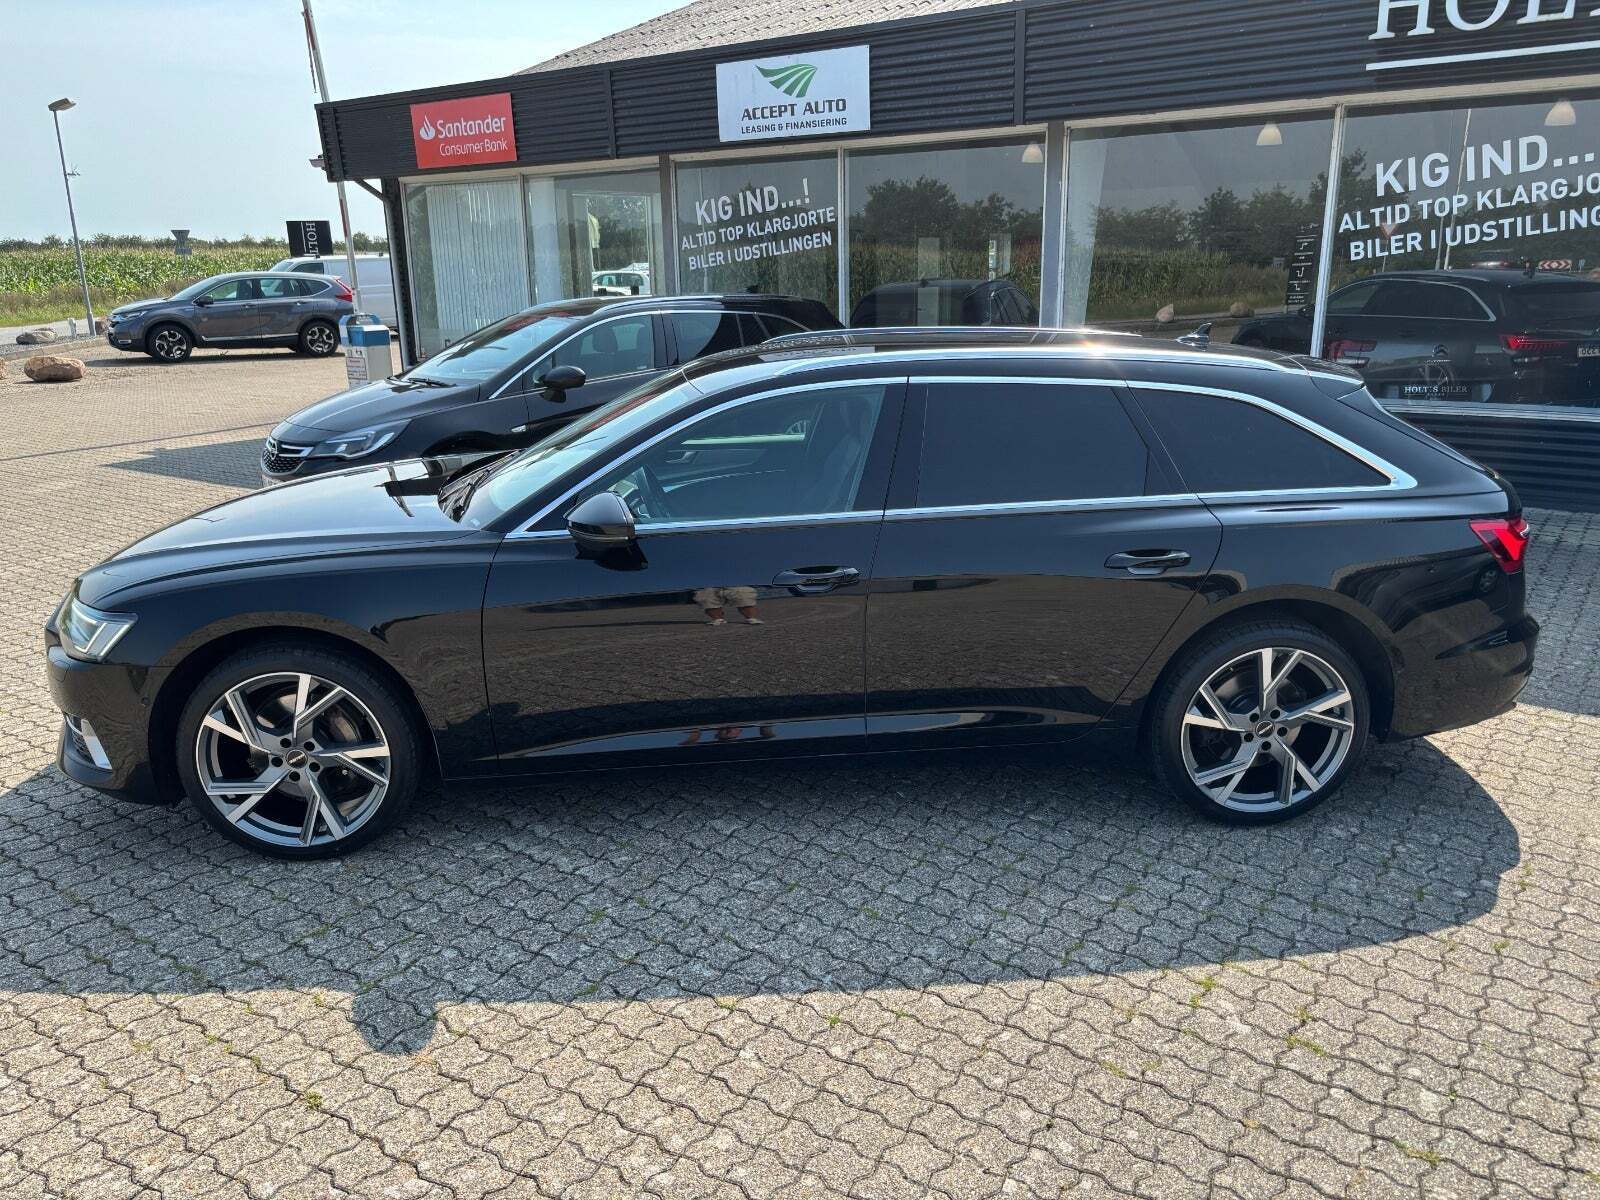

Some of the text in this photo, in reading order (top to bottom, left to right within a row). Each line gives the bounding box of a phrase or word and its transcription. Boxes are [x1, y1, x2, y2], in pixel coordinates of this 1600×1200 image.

[437, 115, 506, 139] Santander
[741, 98, 847, 121] ACCEPT AUTO
[741, 117, 847, 134] LEASING & FINANSIERING
[1376, 152, 1449, 197] KIG
[695, 177, 810, 226] KIG IND...!
[1338, 203, 1411, 234] ALTID
[1418, 194, 1468, 220] TOP
[681, 206, 836, 250] ALTID TOP KLARGJORTE
[1350, 232, 1423, 261] BILER
[1430, 229, 1436, 249] I
[688, 231, 832, 271] BILER I UDSTILLINGEN
